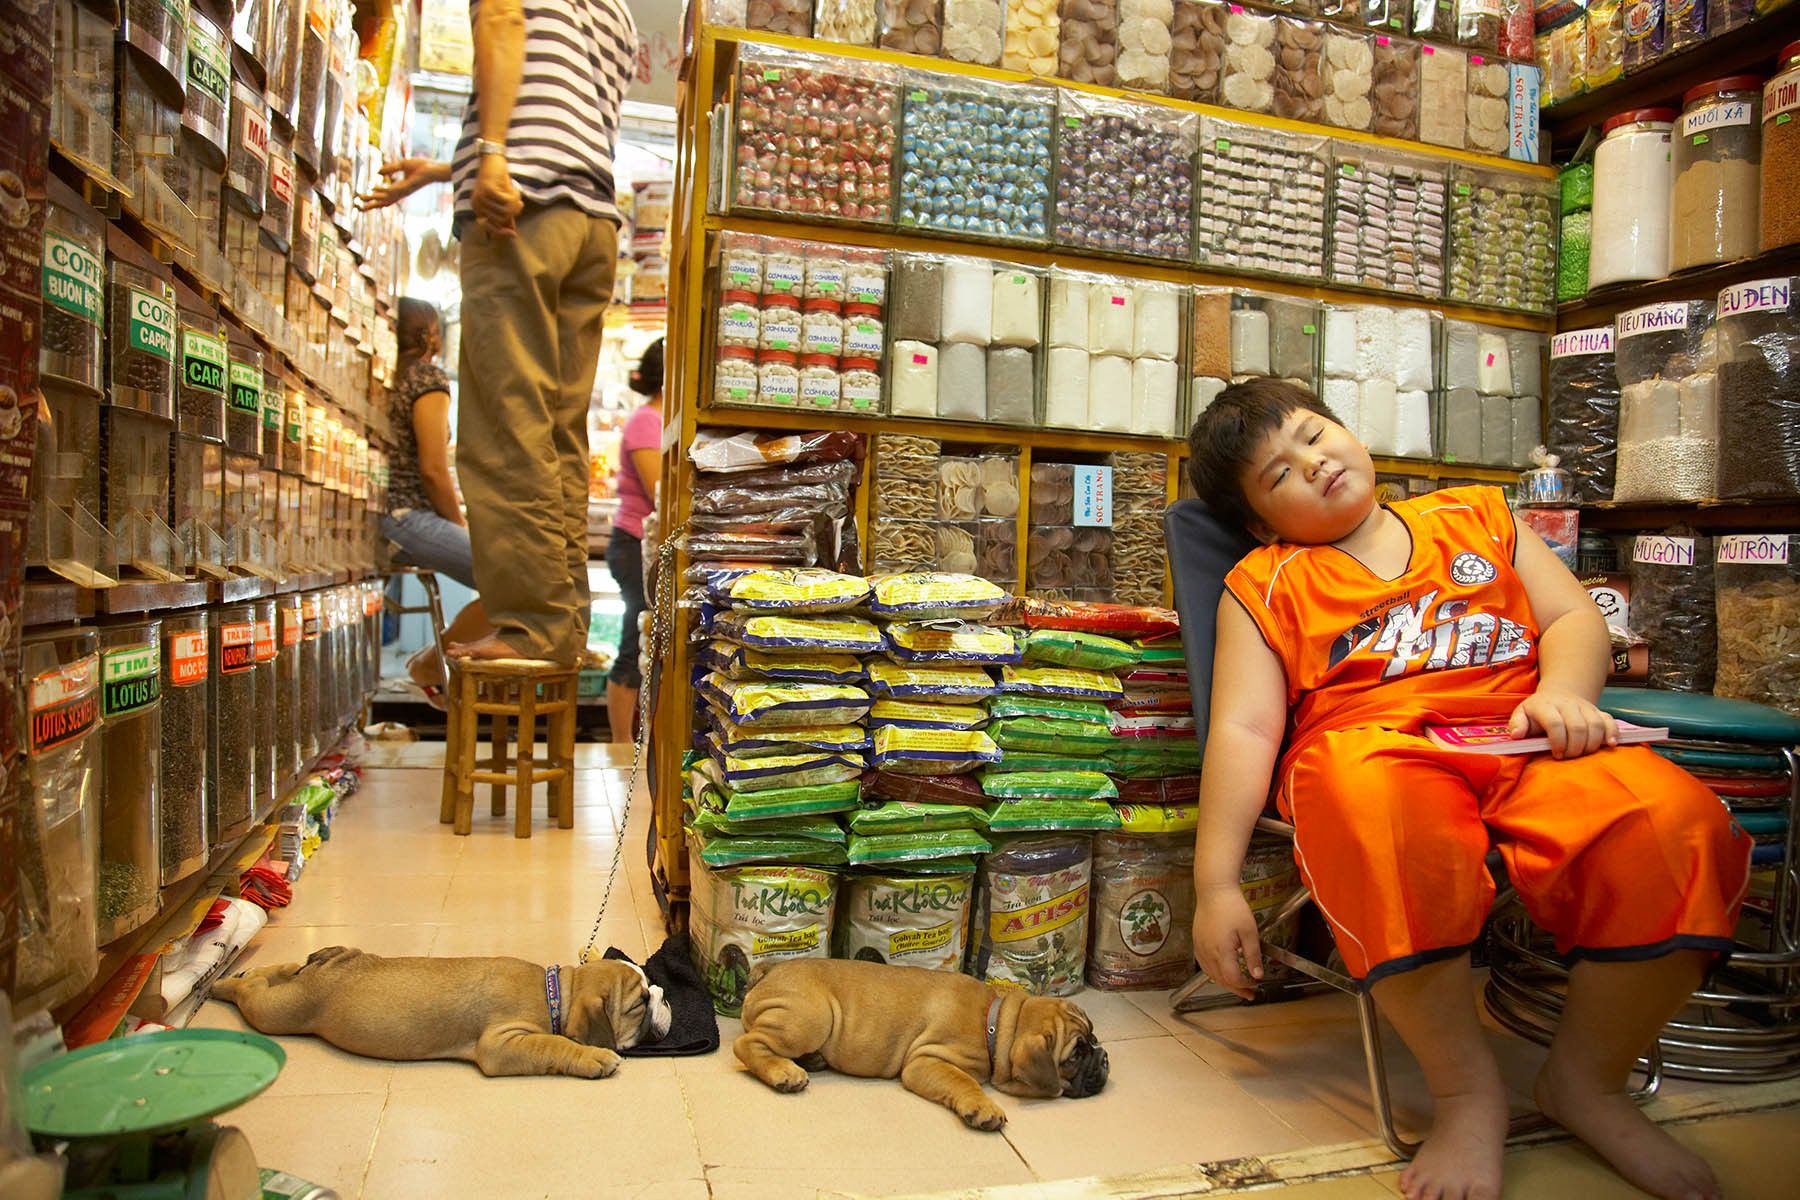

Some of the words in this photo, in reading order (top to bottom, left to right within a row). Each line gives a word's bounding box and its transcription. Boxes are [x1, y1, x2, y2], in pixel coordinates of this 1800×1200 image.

[1360, 591, 1410, 618] streetball
[109, 656, 148, 675] TIM
[112, 679, 149, 709] LOTUS
[36, 710, 67, 743] LOTUS
